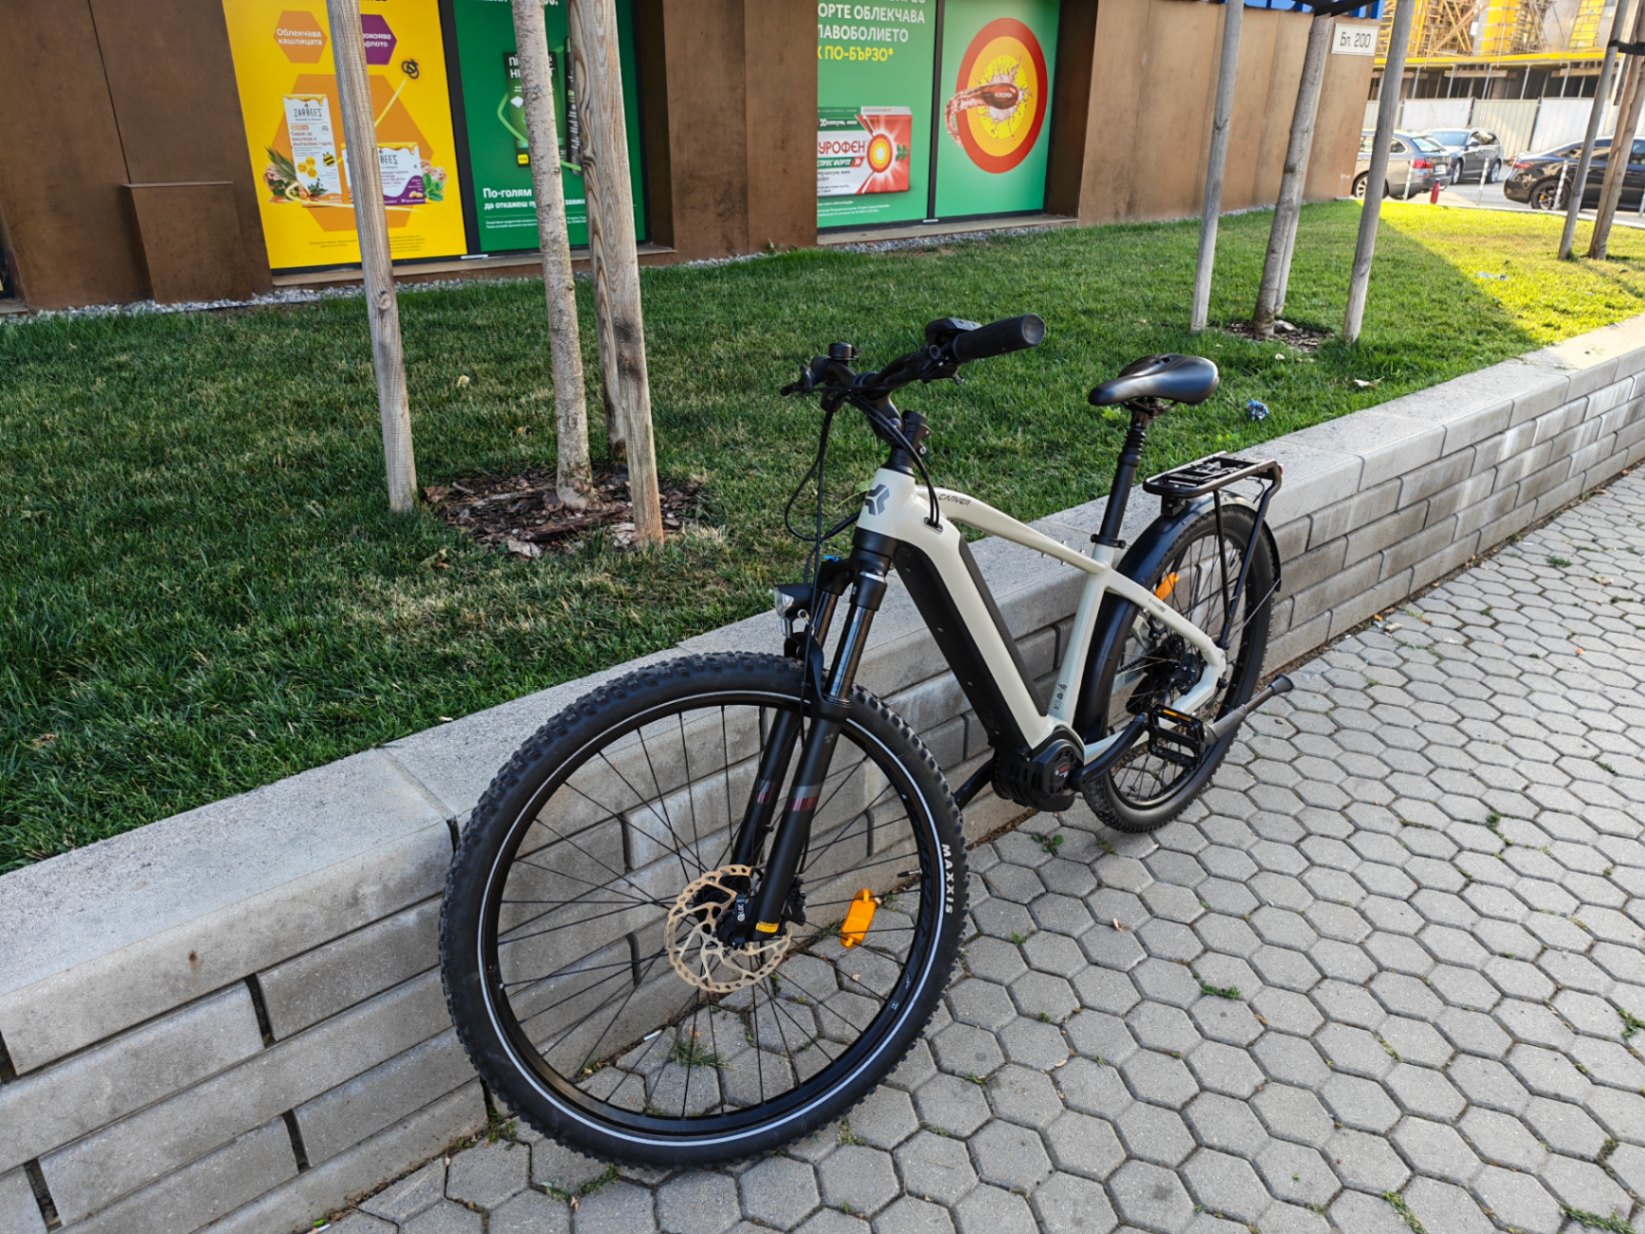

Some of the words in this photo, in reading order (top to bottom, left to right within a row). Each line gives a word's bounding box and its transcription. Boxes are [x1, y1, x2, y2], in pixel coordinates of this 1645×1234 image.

[818, 2, 851, 19] ОРТЕ
[854, 5, 925, 24] ОБЛЕКЧАВА
[276, 28, 322, 38] Облекчава
[818, 24, 909, 42] ЛАВОБОЛИЕТО
[1354, 32, 1372, 48] 200
[818, 140, 865, 155] УРОФЕН
[483, 187, 532, 199] По-голям
[495, 201, 528, 209] откажеш
[564, 198, 586, 206] завин
[938, 493, 972, 506] CARVER
[942, 843, 955, 914] MAXXIS
